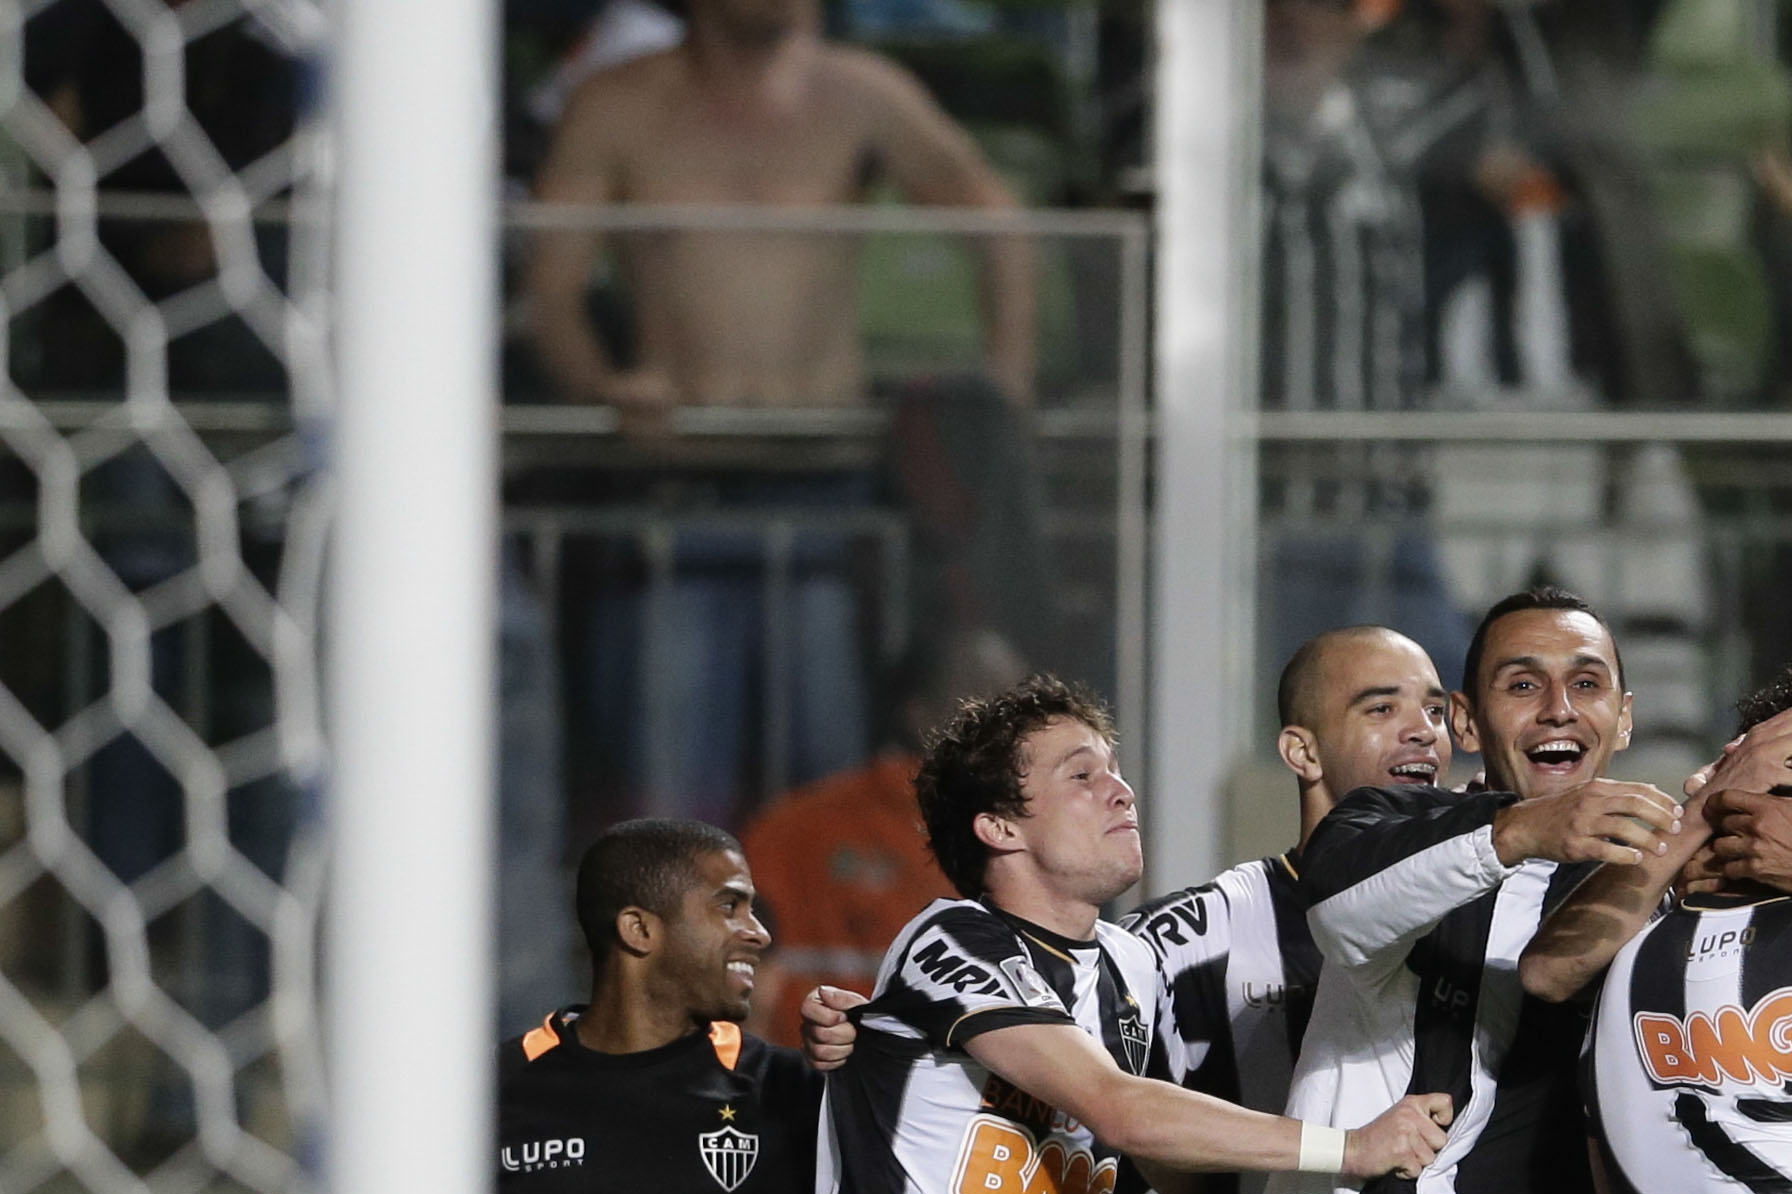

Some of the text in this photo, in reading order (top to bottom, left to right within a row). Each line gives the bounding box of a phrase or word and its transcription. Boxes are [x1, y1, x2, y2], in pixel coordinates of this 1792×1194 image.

[1684, 927, 1757, 962] LUPO
[501, 1138, 585, 1172] LUPO
[707, 1138, 751, 1150] CAM
